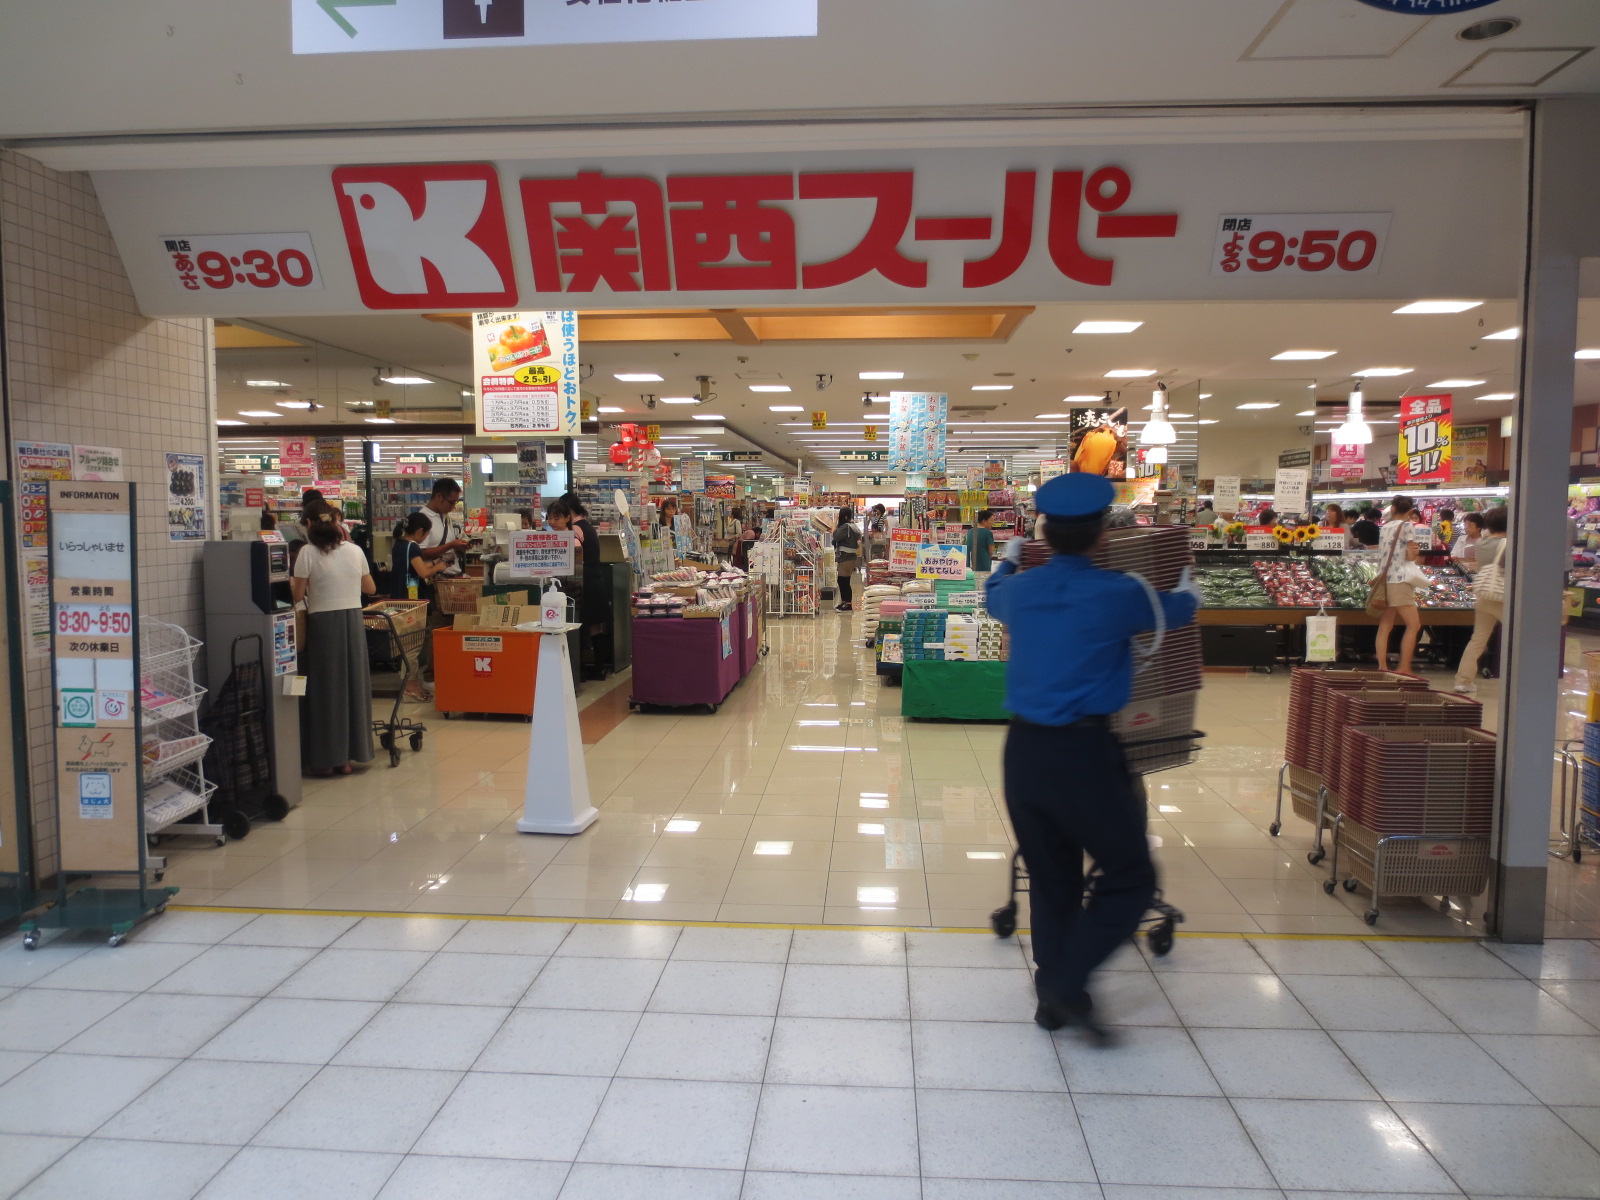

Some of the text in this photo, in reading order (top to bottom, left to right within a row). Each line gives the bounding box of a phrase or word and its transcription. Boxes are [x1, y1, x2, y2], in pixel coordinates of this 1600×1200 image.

[519, 167, 1178, 292] 関西スーパー
[1223, 218, 1252, 231] 閉店
[165, 240, 191, 252] 開店
[1220, 231, 1245, 272] よる
[1247, 230, 1377, 272] 9:50
[172, 253, 200, 290] あさ
[197, 249, 313, 289] 9:30
[528, 367, 545, 375] 最高
[1409, 399, 1442, 415] 全品
[1403, 420, 1450, 456] 10%
[262, 455, 269, 464] 7
[428, 454, 435, 462] 6
[725, 452, 731, 460] 4
[871, 451, 877, 460] 3
[1409, 450, 1443, 477] 引!
[60, 491, 119, 500] INFORMATION
[59, 541, 125, 552] いらっしゃいませ
[925, 557, 959, 566] おみやげや
[920, 566, 962, 575] おもてなしに
[70, 586, 114, 597] 営業時間
[69, 642, 120, 653] 次の休業日
